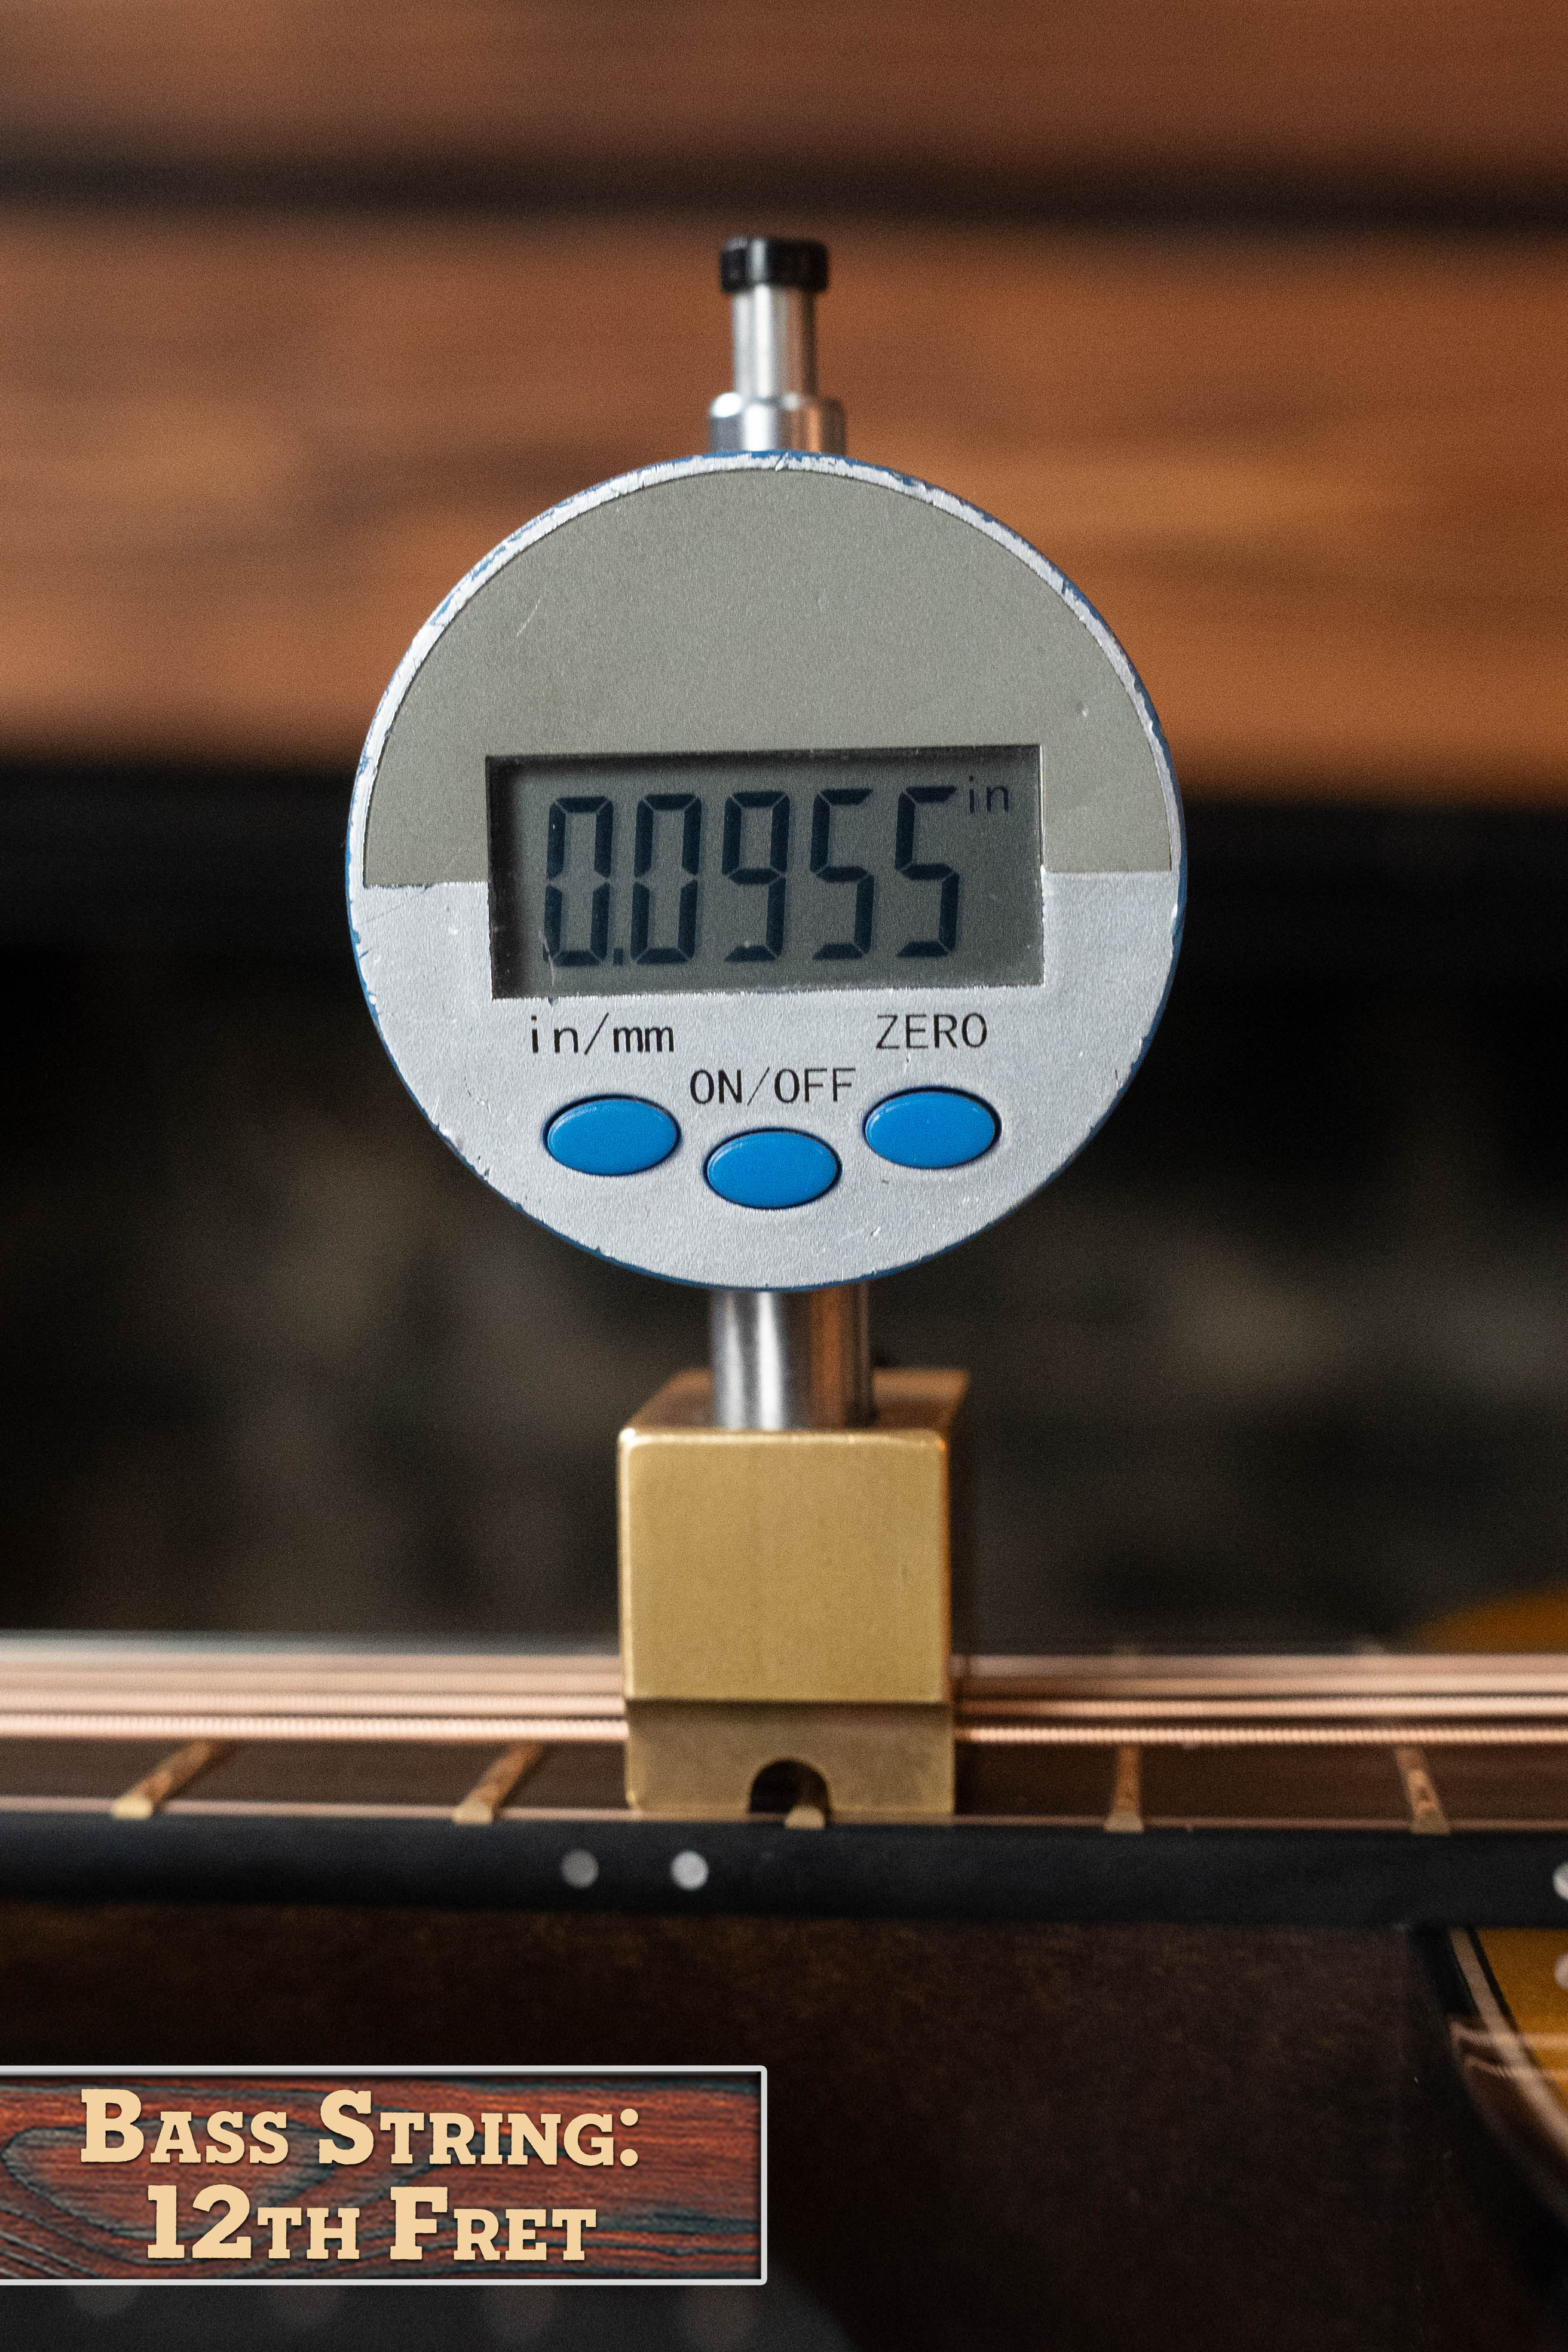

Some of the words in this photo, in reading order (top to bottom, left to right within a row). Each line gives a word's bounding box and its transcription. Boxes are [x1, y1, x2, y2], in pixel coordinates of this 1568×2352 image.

[543, 786, 960, 967] 0.0955
[967, 775, 1010, 815] in
[530, 1012, 676, 1054] in/mm
[875, 1012, 988, 1051] ZERO
[689, 1066, 857, 1107] ON/OFF
